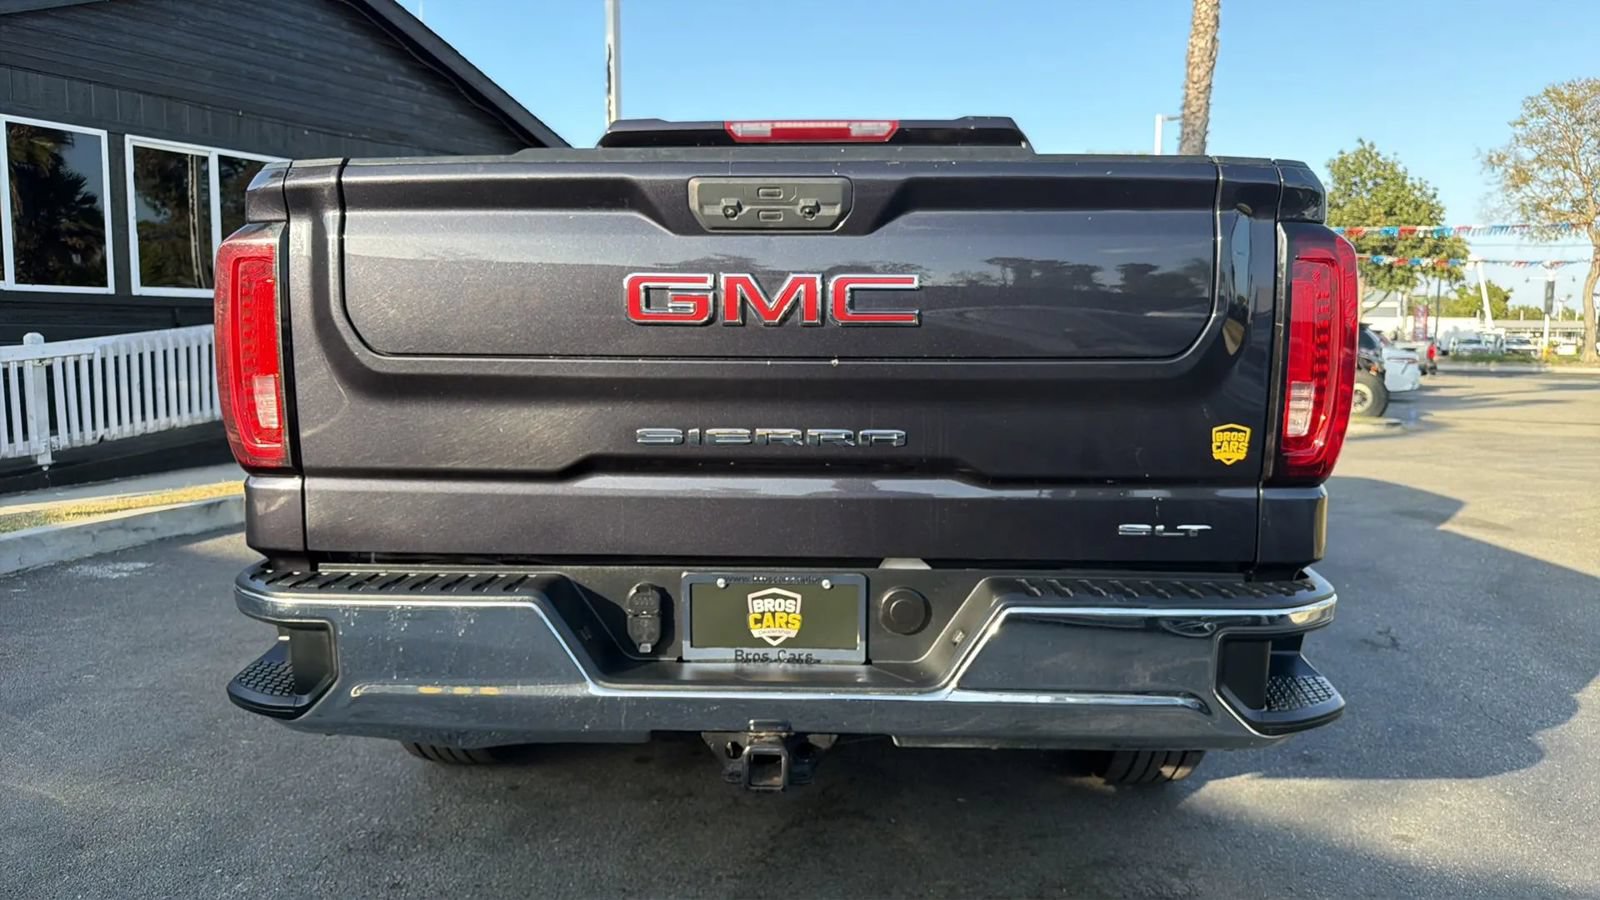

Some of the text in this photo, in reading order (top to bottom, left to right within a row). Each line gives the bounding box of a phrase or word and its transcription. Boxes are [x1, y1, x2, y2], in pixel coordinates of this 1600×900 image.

[622, 272, 920, 326] GMC
[636, 428, 906, 447] SIERRA
[1215, 431, 1246, 442] BROS
[1212, 441, 1249, 453] CARS
[1118, 524, 1212, 536] SLT
[752, 598, 797, 613] BROS
[748, 611, 802, 630] CARS
[734, 649, 770, 663] Bros
[777, 649, 813, 663] Cars
